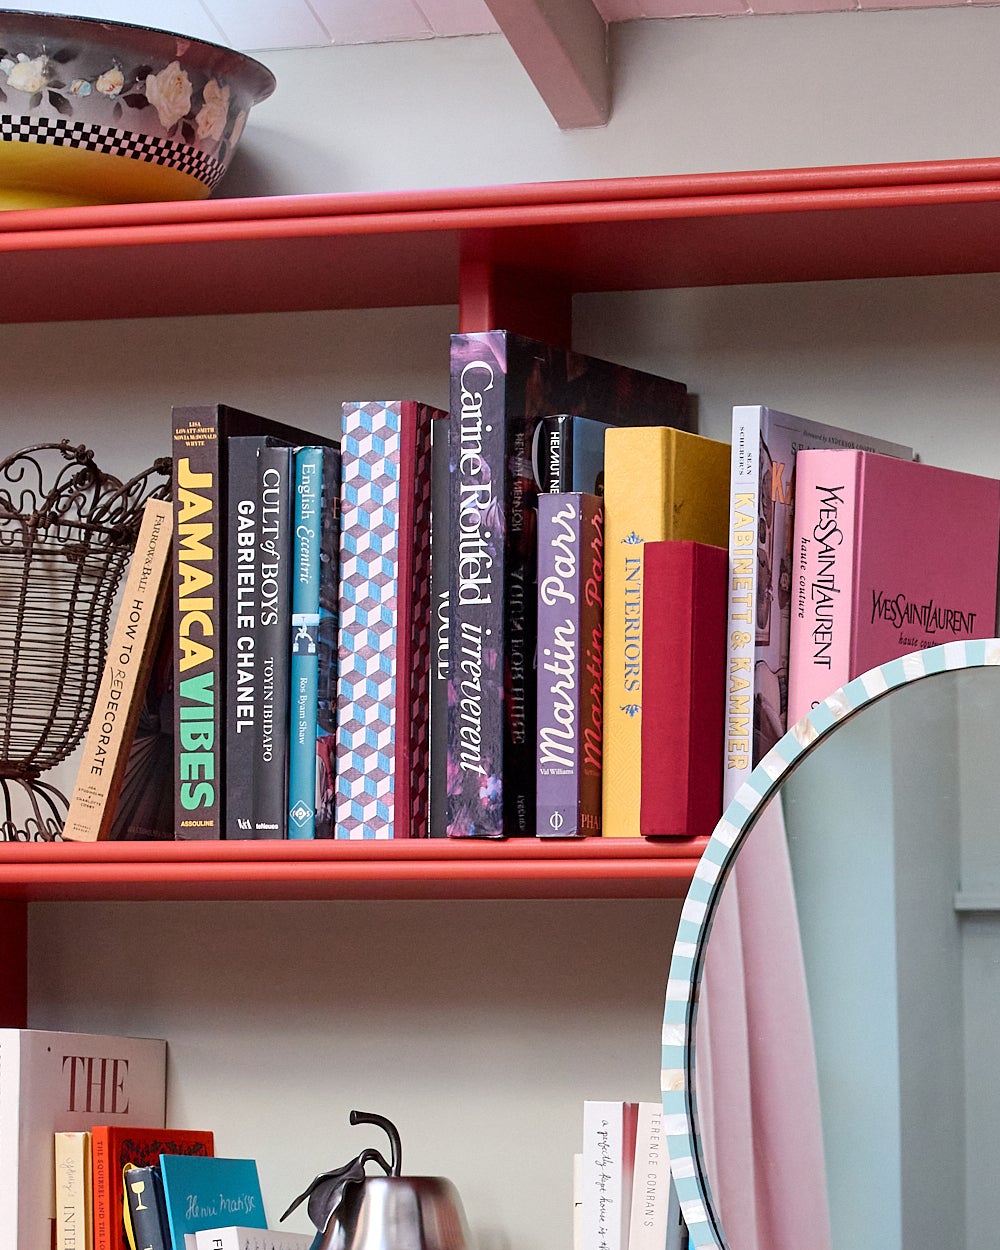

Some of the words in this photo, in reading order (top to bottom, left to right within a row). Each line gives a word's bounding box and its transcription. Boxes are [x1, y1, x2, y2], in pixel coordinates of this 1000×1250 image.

[459, 360, 494, 475] Carine
[549, 432, 560, 477] HELMUT
[262, 468, 281, 540] CULT
[298, 463, 315, 520] English
[237, 500, 256, 629] GABRIELLE
[260, 540, 281, 561] of
[296, 525, 315, 584] Eccentric
[459, 481, 494, 606] Roitfeld
[540, 503, 576, 606] Parr
[731, 493, 755, 627] KABINETT
[799, 537, 810, 571] haute
[124, 599, 143, 640] HOW
[261, 563, 279, 626] BOYS
[797, 576, 808, 618] couture
[624, 557, 642, 692] INTERIORS
[731, 631, 751, 652] &
[119, 645, 134, 665] TO
[263, 657, 275, 701] TOYIN
[236, 636, 255, 734] CHANEL
[298, 695, 308, 718] Byam
[299, 677, 309, 693] Ros
[460, 623, 492, 778] irreverent
[540, 619, 576, 768] Martin
[262, 705, 274, 762] IBIDAPO
[298, 721, 308, 745] Shaw
[728, 657, 752, 771] KAMMER
[62, 1055, 129, 1114] THE
[648, 1113, 661, 1167] TERENCE
[97, 1158, 105, 1198] SQUIRREL
[185, 1192, 217, 1219] Henri
[98, 1201, 106, 1220] AND
[98, 1222, 106, 1237] THE
